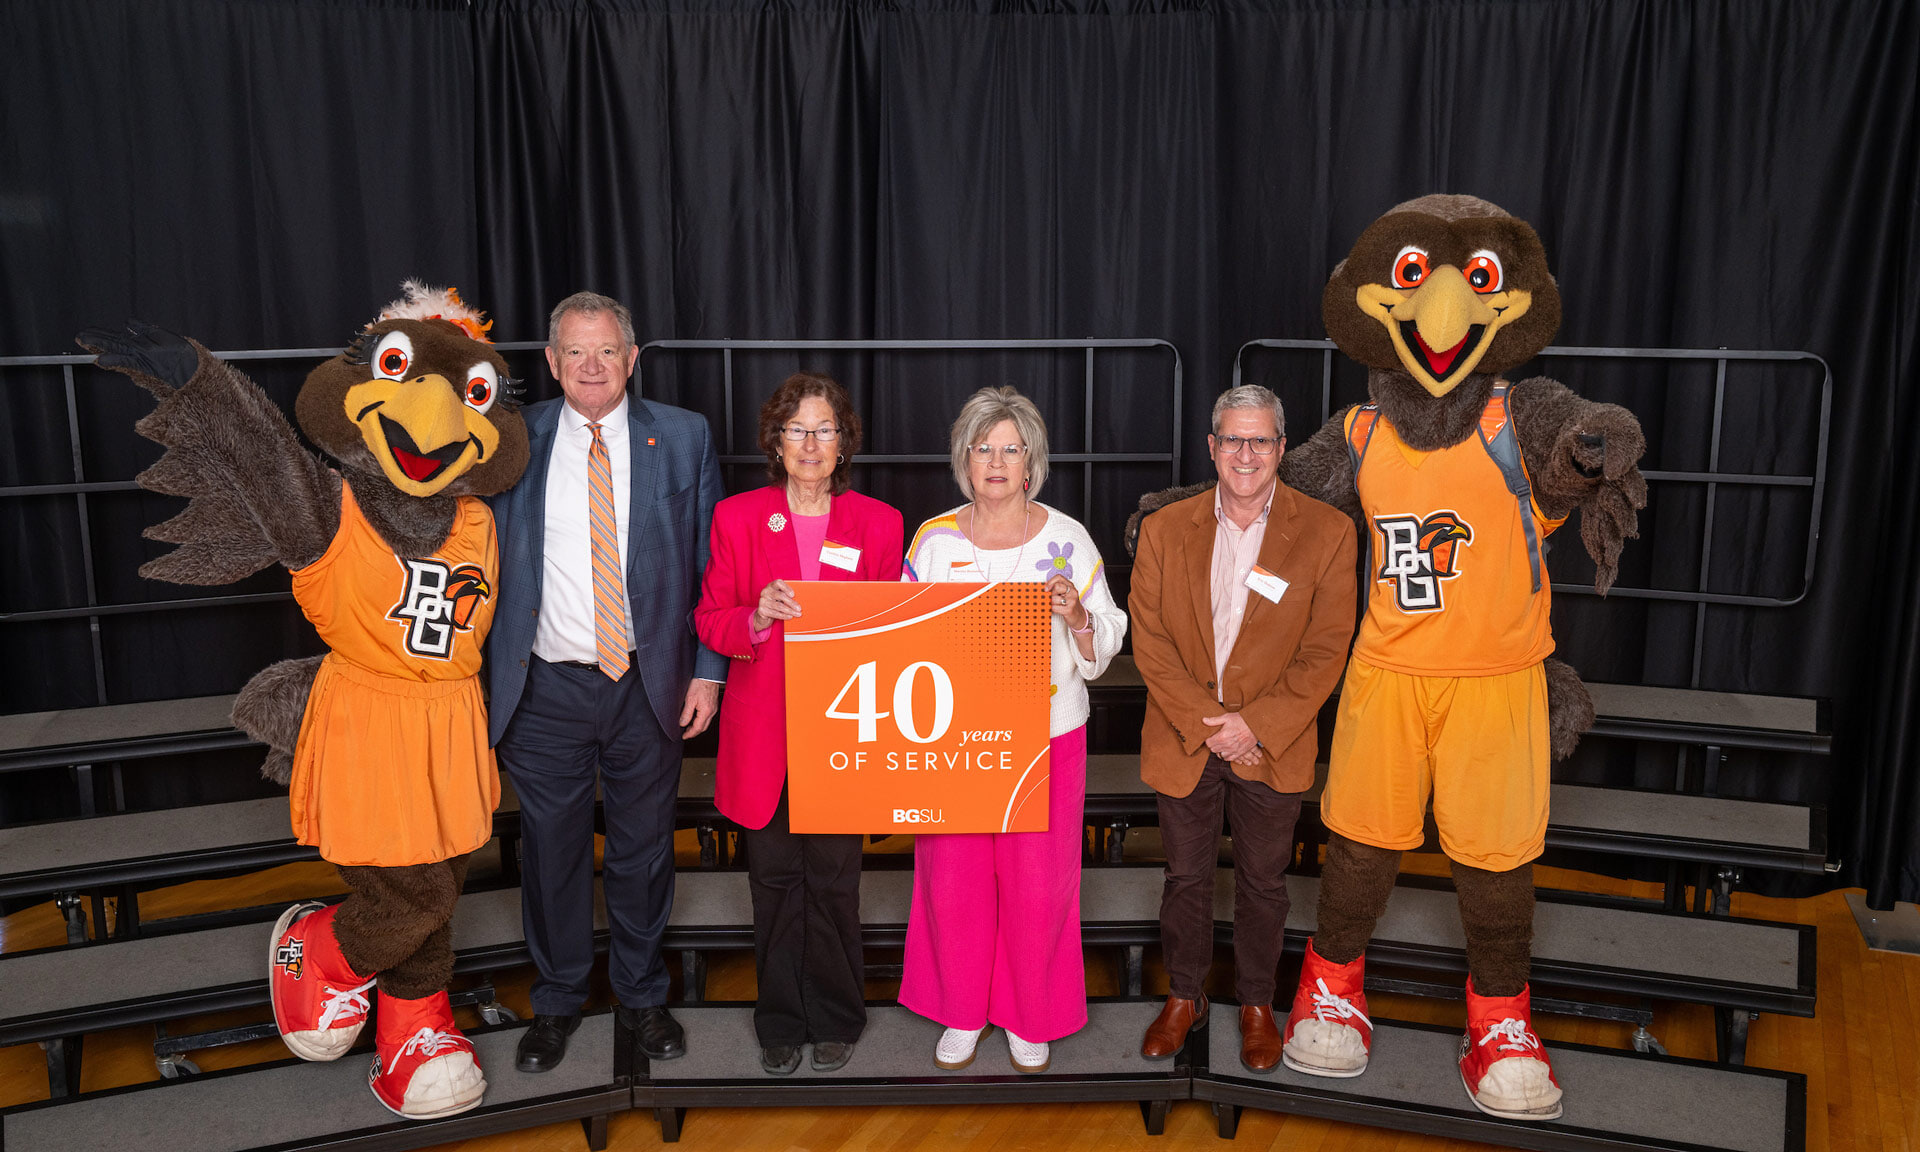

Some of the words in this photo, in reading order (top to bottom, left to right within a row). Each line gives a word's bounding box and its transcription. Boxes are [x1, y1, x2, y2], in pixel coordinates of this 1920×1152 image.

[825, 660, 954, 744] 40
[959, 729, 1013, 747] years
[829, 751, 868, 771] OF
[886, 751, 1013, 771] SERVICE
